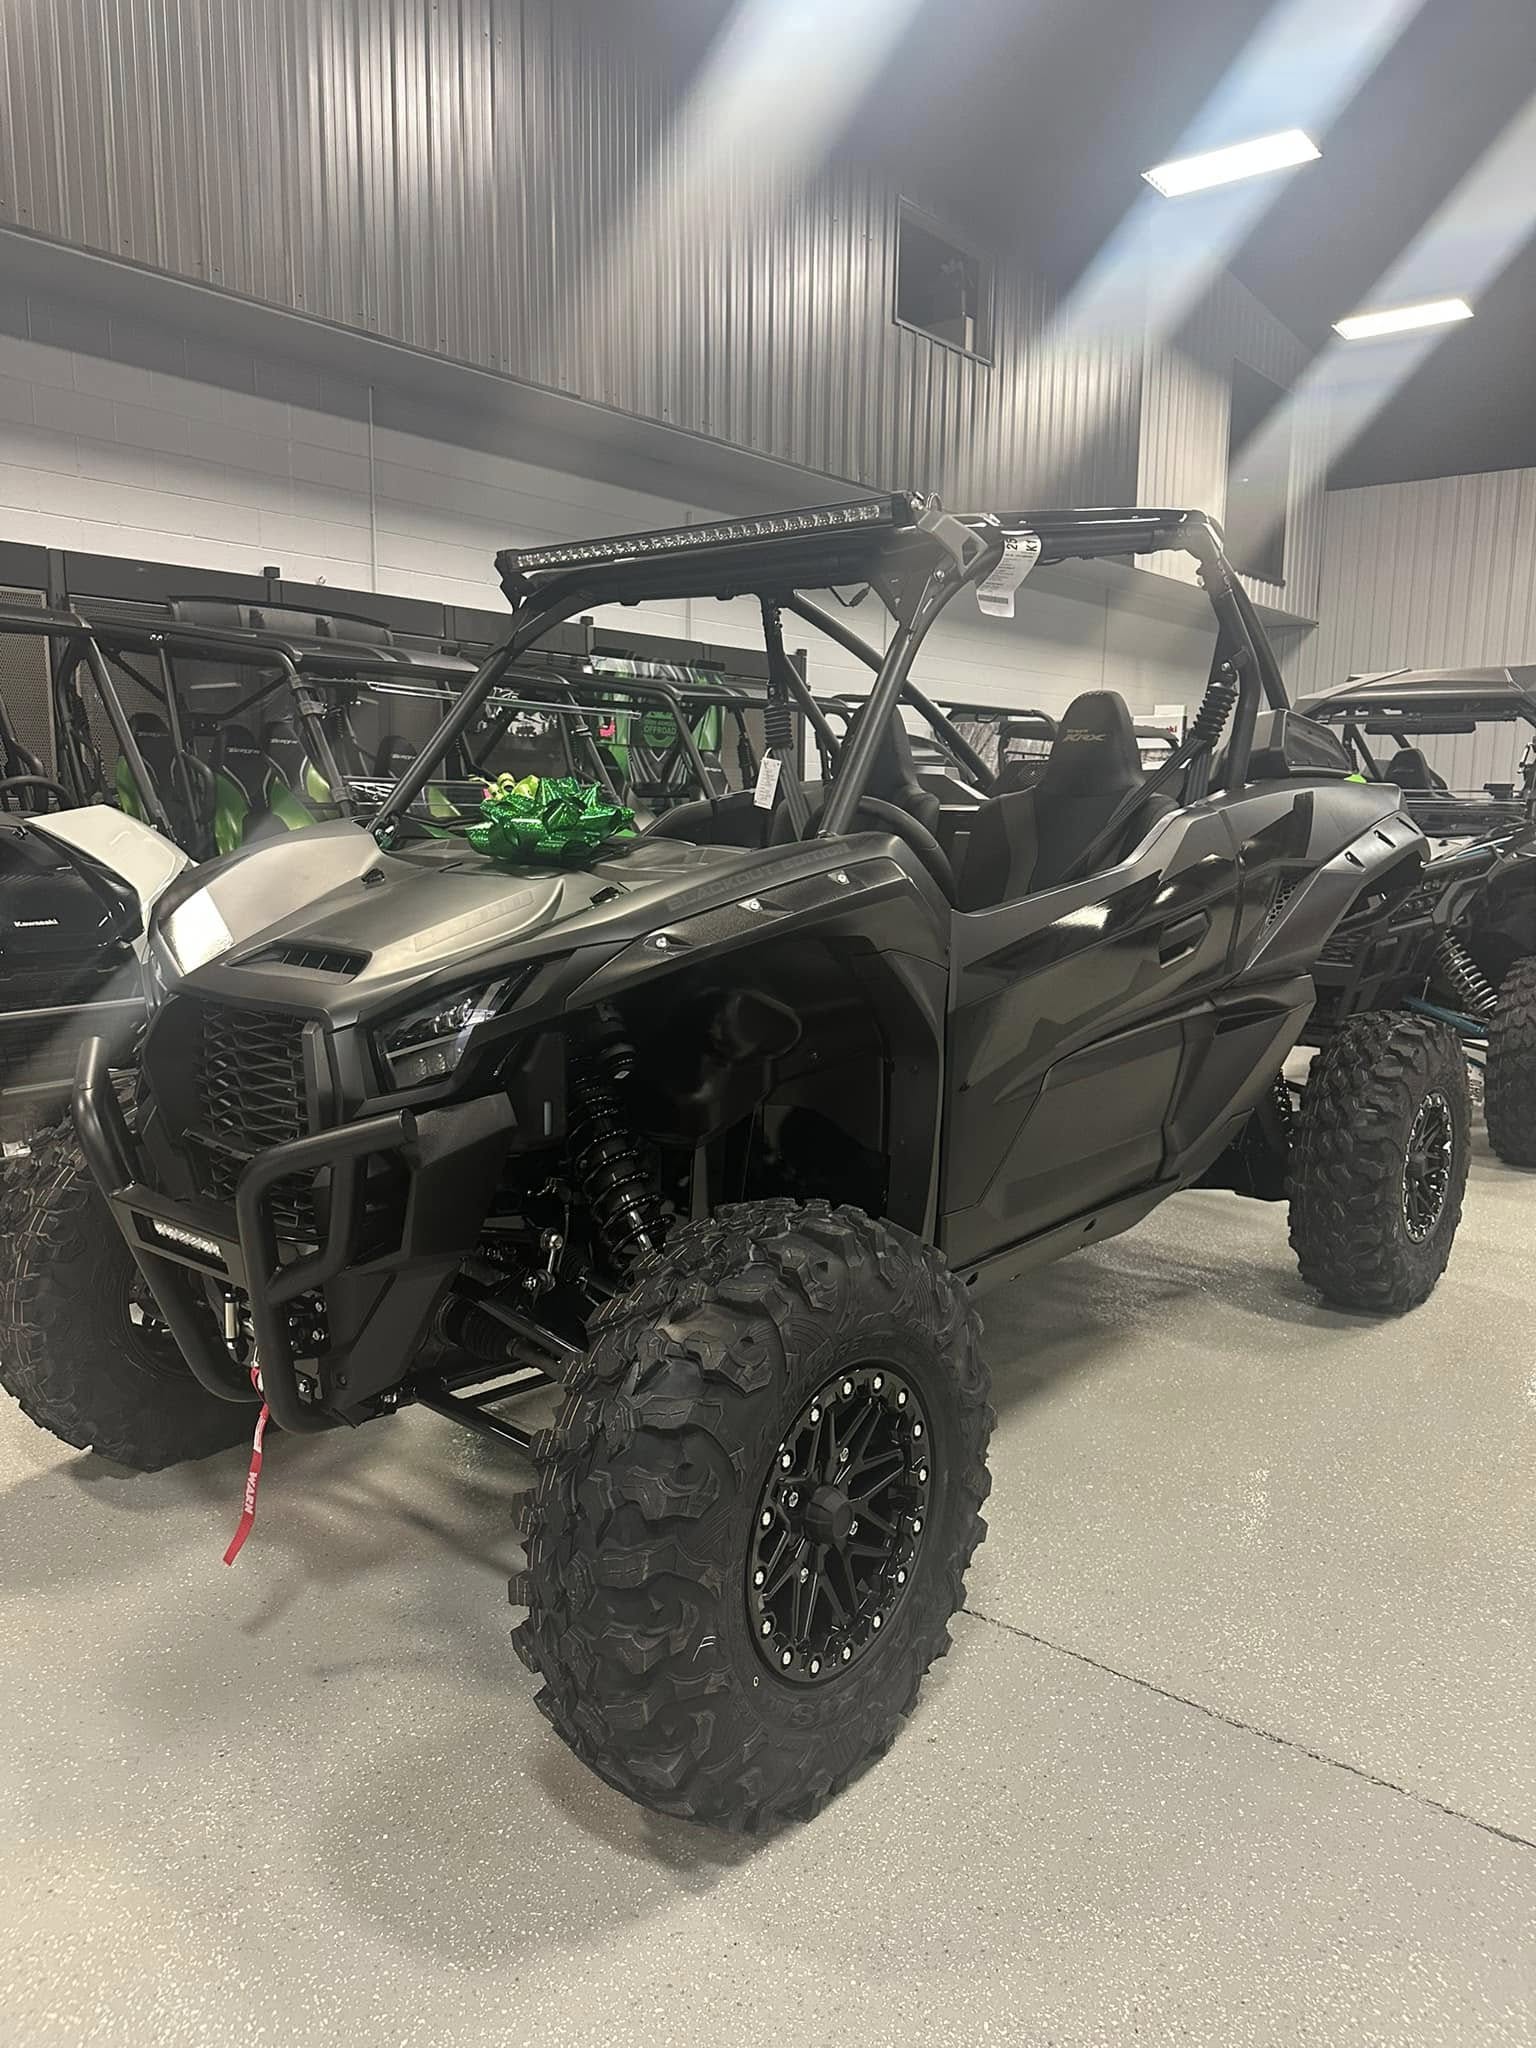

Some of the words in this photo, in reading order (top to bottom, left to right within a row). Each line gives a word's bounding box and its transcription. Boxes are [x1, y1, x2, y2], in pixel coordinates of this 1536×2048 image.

[667, 864, 774, 911] BLACKOUT
[782, 842, 853, 874] EDITION
[244, 1472, 258, 1515] WARN
